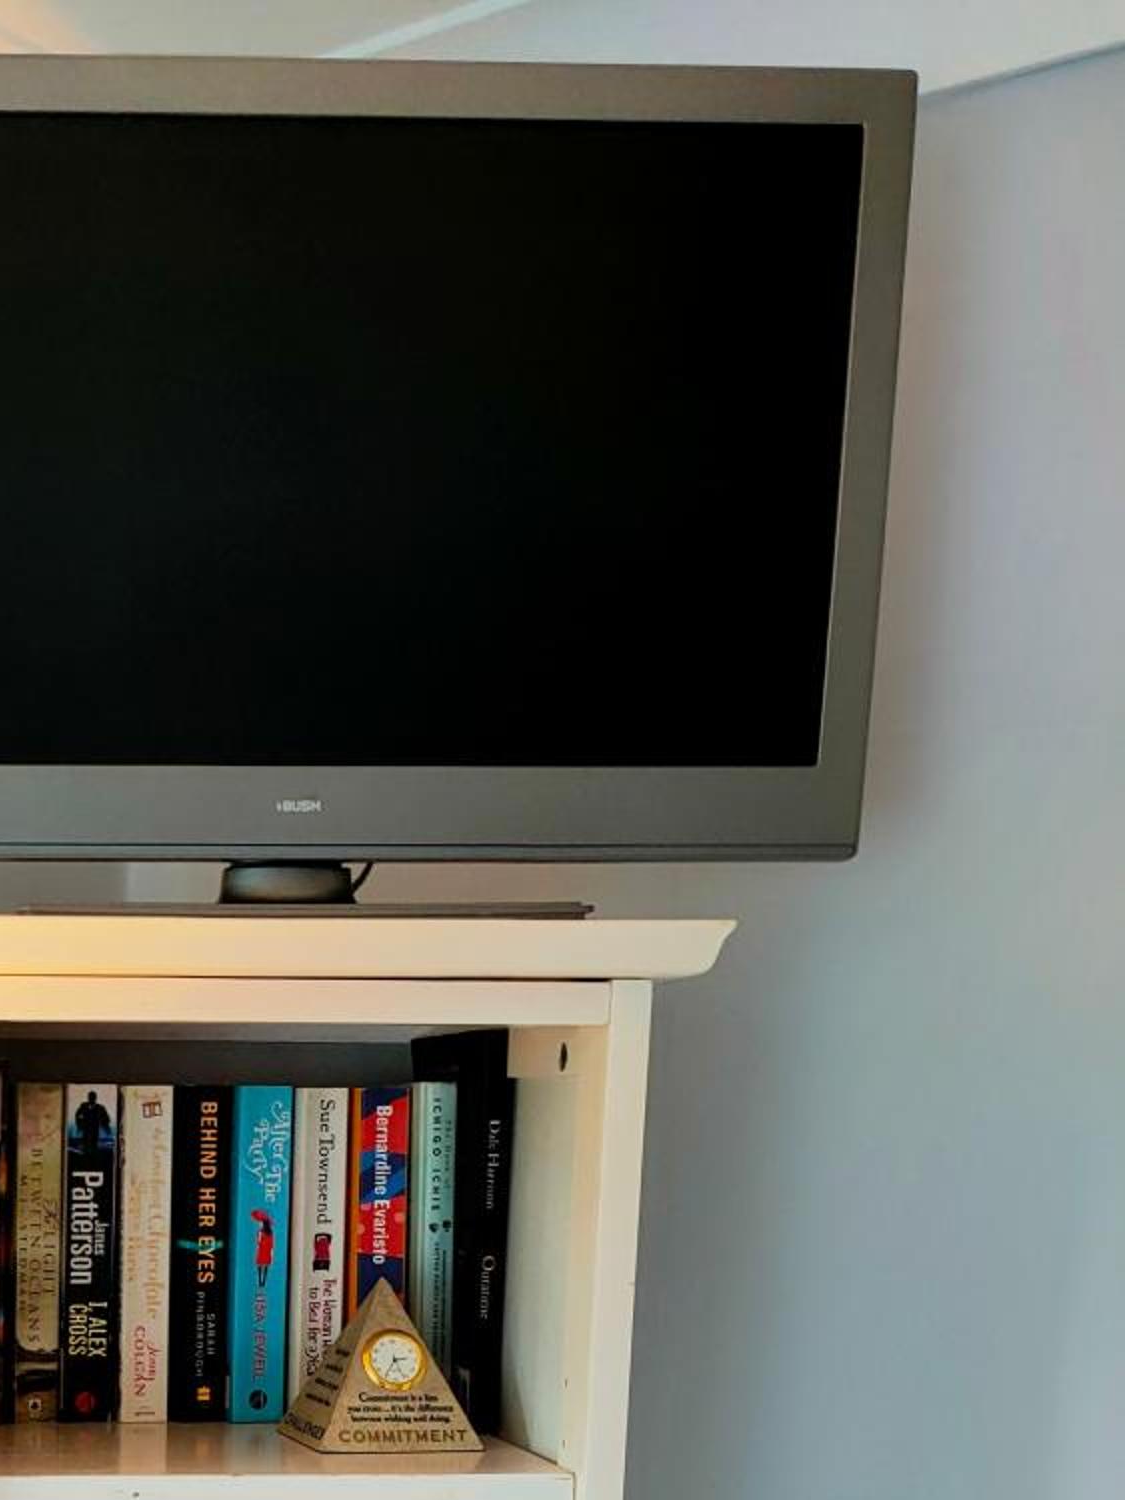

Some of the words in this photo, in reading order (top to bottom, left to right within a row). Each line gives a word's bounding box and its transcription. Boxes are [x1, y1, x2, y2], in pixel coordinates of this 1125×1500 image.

[281, 799, 322, 812] BUSH
[200, 1101, 218, 1179] BEHIND
[269, 1101, 291, 1161] After
[320, 1099, 336, 1133] Sue
[431, 1097, 443, 1158] ICHIGO
[244, 1118, 270, 1185] Party
[265, 1158, 287, 1203] The
[316, 1134, 336, 1225] Townsend
[374, 1105, 393, 1196] Bernardine
[28, 1147, 43, 1249] BETWEEN
[198, 1187, 216, 1227] HER
[431, 1168, 442, 1211] ICHIE
[70, 1171, 104, 1285] Patterson
[94, 1219, 109, 1256] James
[372, 1199, 391, 1265] Evaristo
[43, 1230, 57, 1297] LIGHT
[196, 1235, 216, 1284] EYES
[27, 1258, 43, 1344] OCEANS
[308, 1287, 320, 1299] to
[68, 1304, 89, 1356] CROSS
[88, 1317, 108, 1357] ALEX
[195, 1291, 206, 1377] PINBOROUGH
[206, 1313, 216, 1355] SARAH
[134, 1325, 146, 1397] COLGAN
[338, 1429, 468, 1444] COMMITMENT
